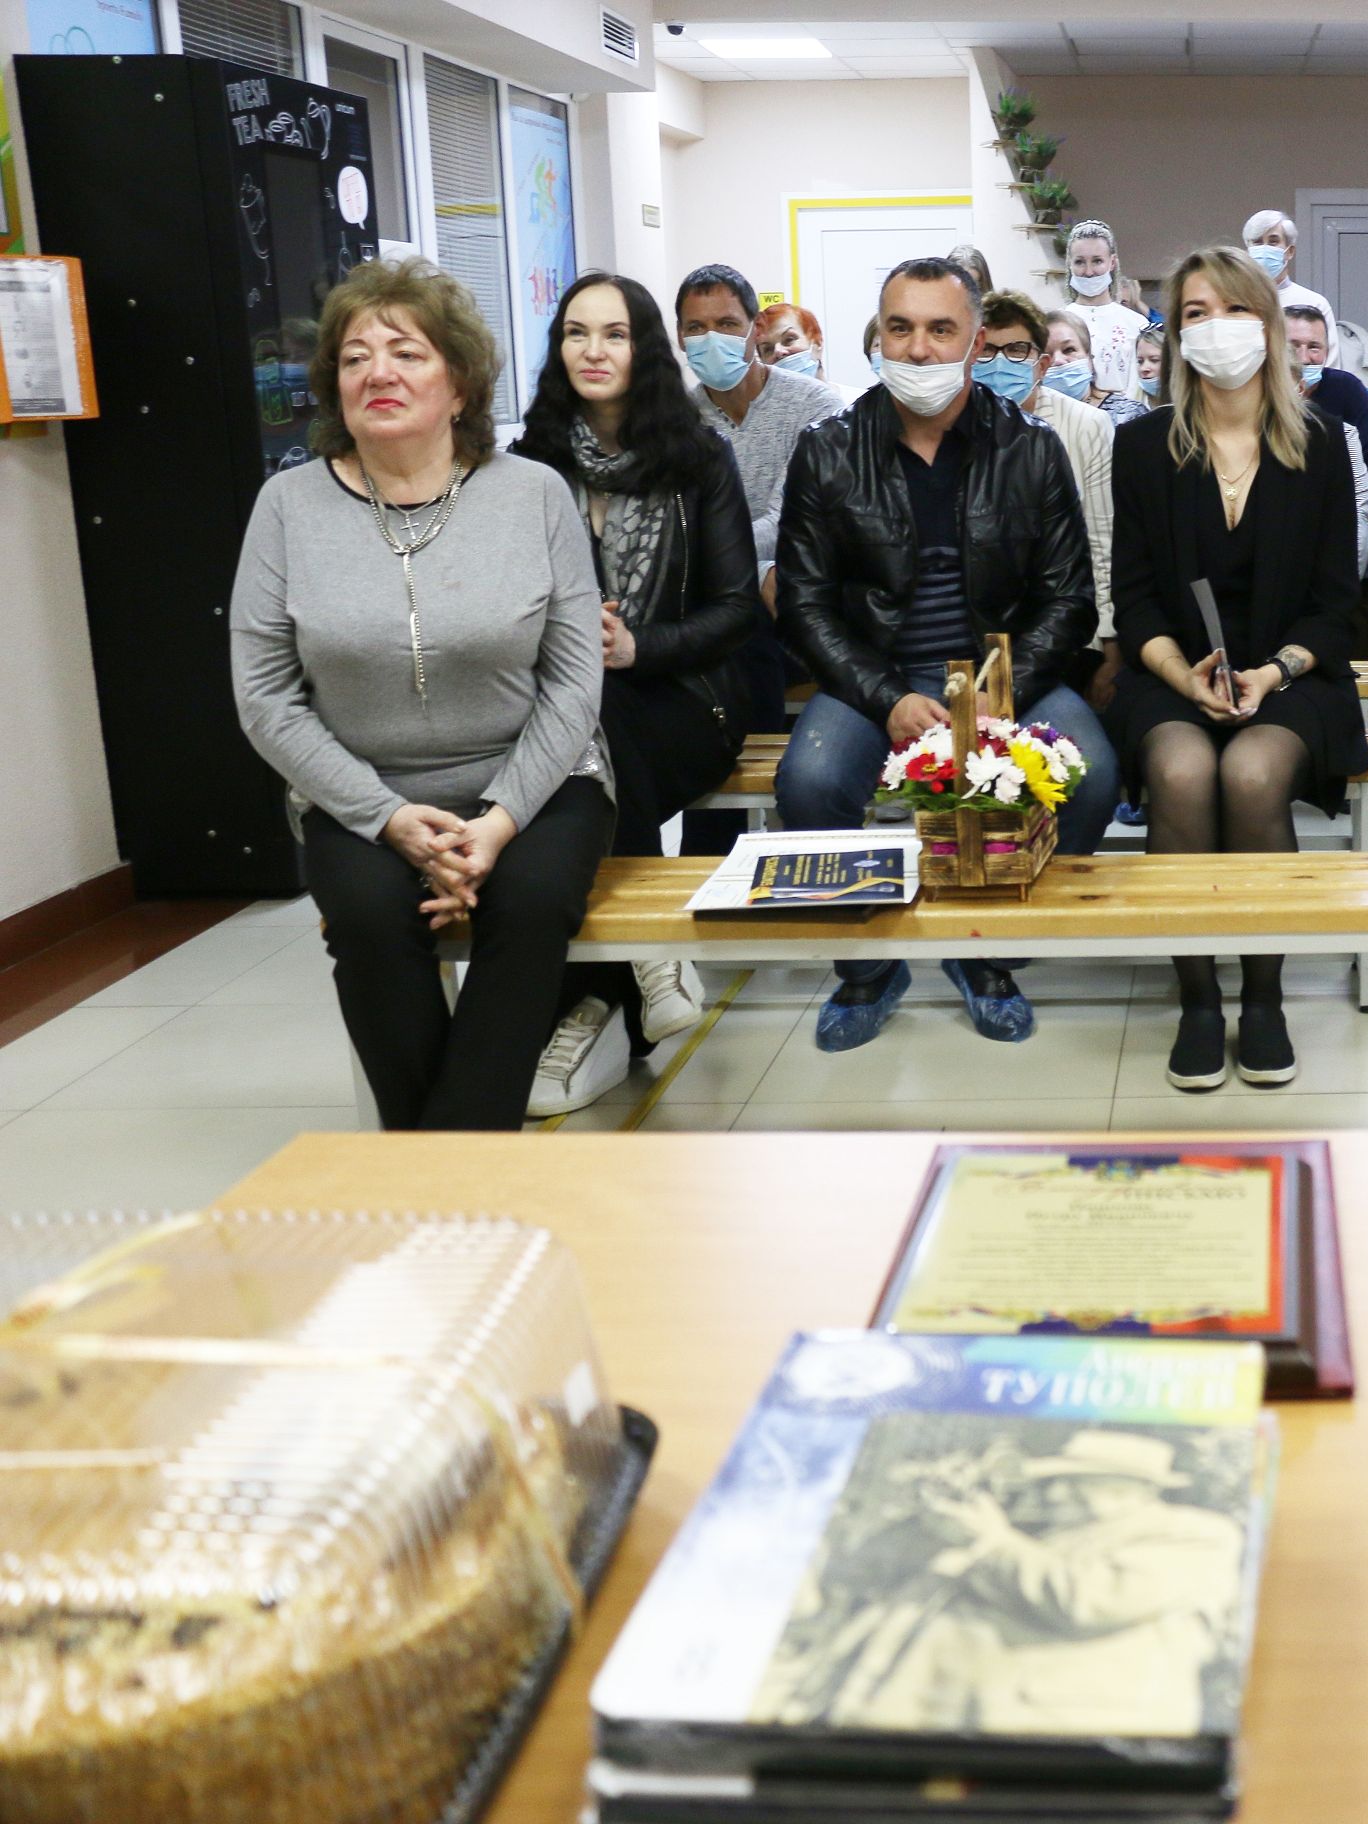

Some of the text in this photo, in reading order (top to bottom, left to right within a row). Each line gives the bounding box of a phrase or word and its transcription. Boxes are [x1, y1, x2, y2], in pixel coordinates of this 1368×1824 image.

[226, 78, 271, 112] FRESH
[232, 114, 264, 146] TEA
[763, 294, 780, 303] WC
